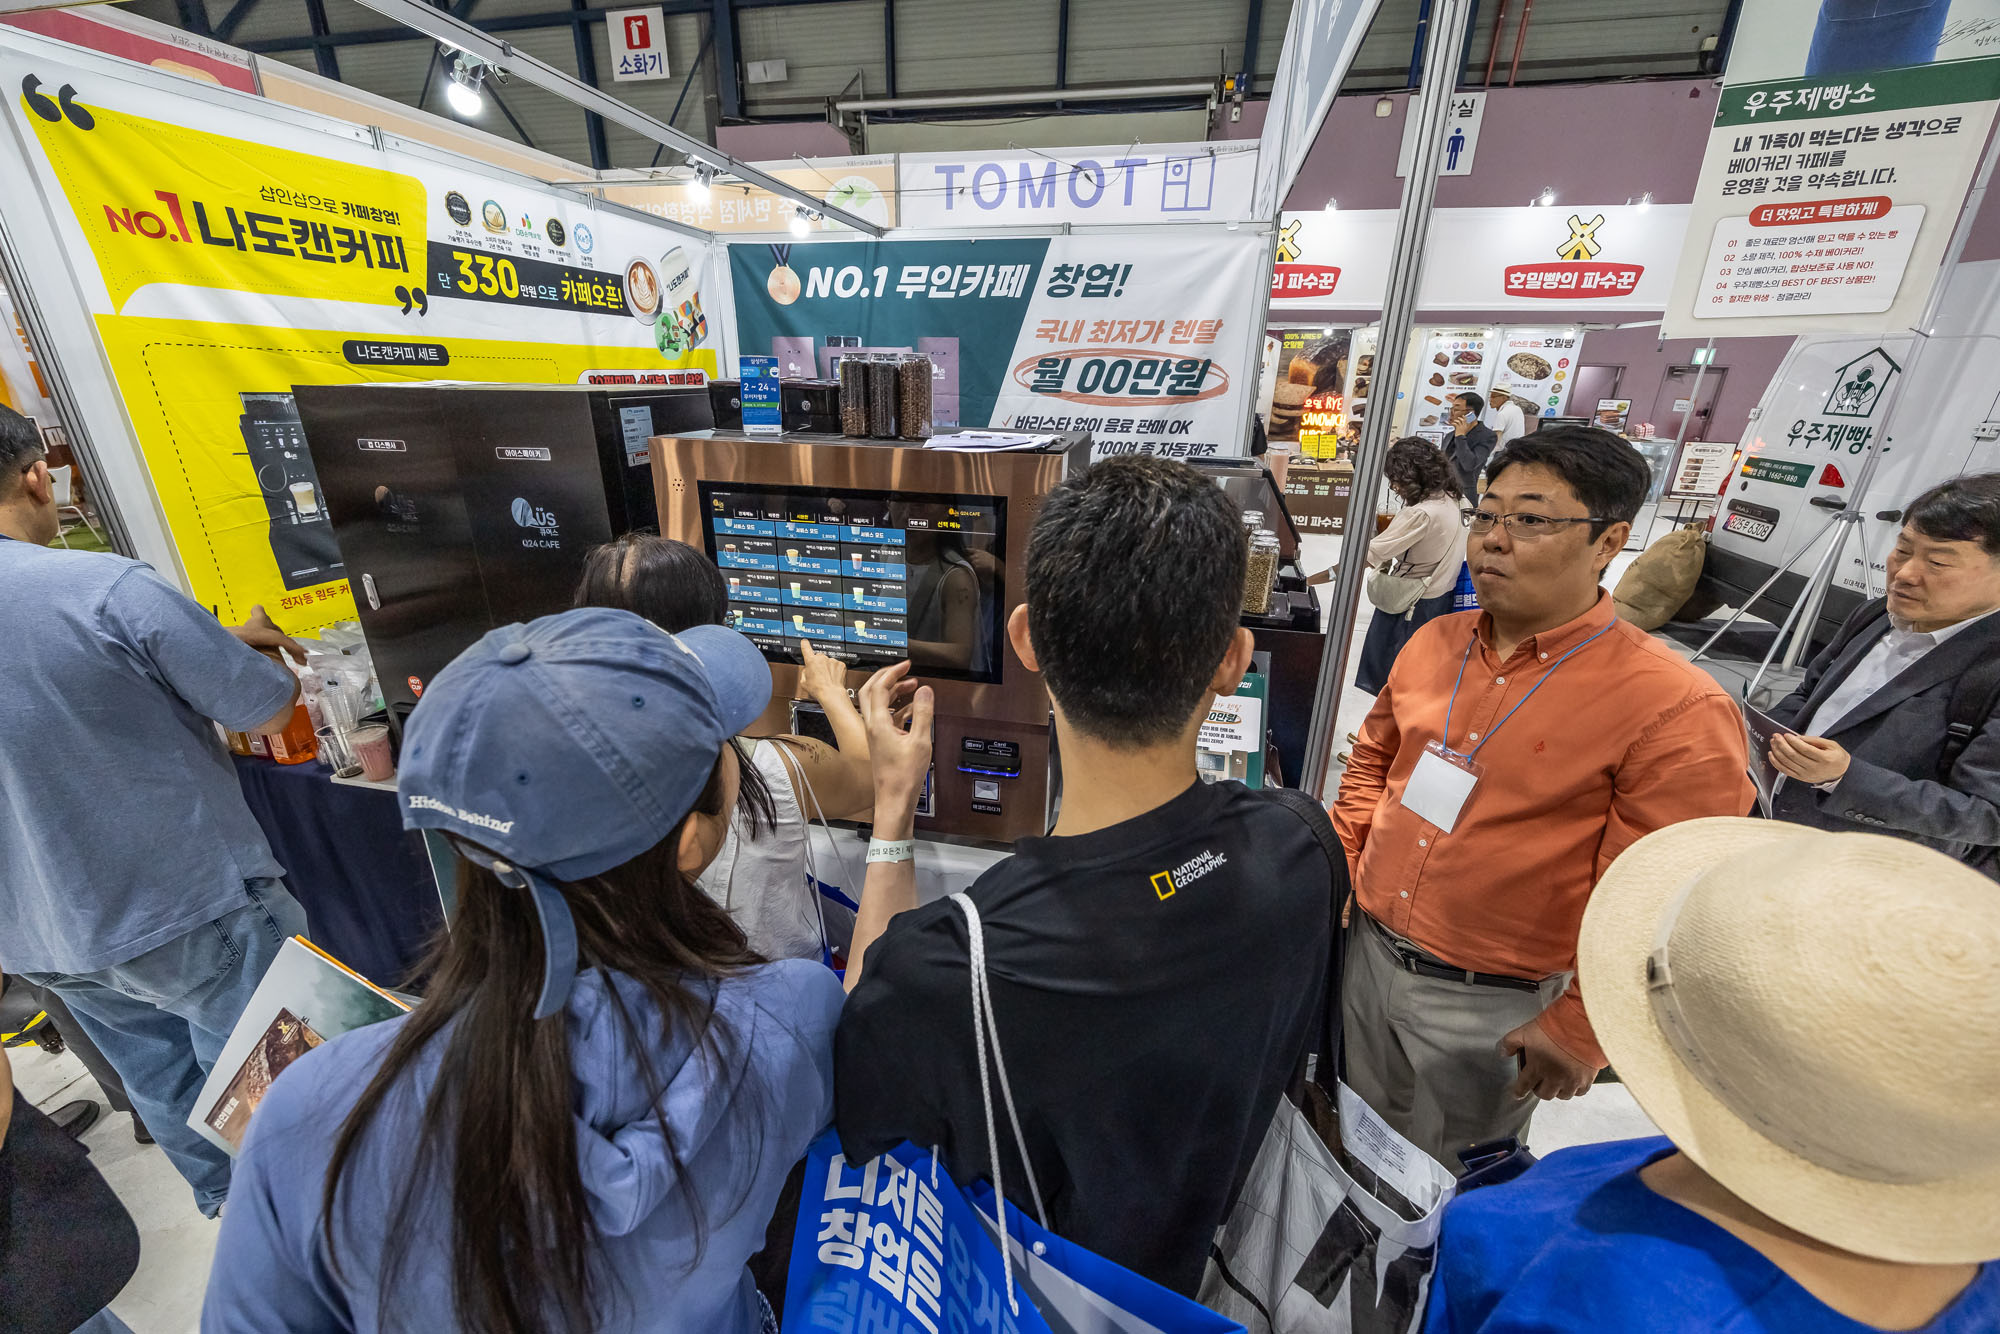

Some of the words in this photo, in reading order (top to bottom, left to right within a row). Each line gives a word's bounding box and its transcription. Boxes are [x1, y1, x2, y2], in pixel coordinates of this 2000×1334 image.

[619, 52, 663, 75] 소화기
[1744, 82, 1876, 118] 우주제빵소
[1733, 135, 1753, 153] 내
[1758, 131, 1804, 151] 가족이
[1809, 126, 1880, 148] 먹는다는
[1886, 116, 1962, 141] 생각으로
[1727, 154, 1790, 175] 베이커리
[1795, 149, 1847, 170] 카페를
[1722, 177, 1770, 197] 운영할
[1771, 175, 1803, 193] 것을
[1807, 167, 1898, 190] 약속합니다.
[259, 185, 339, 214] 샵인샵으로
[341, 201, 401, 227] 카페창업!
[1760, 206, 1773, 221] 더
[1776, 205, 1814, 221] 맛있고
[1817, 201, 1880, 218] 특별하게!
[102, 189, 193, 244] NO.1
[192, 200, 409, 274] 나도캔커피
[1727, 239, 1738, 248] 01
[1762, 237, 1788, 247] 재료만
[1817, 233, 1835, 243] 믿고
[1837, 232, 1856, 242] 먹을
[1857, 231, 1867, 241] 수
[1868, 231, 1887, 240] 있는
[1888, 229, 1899, 239] 빵
[1723, 254, 1736, 262] 02
[1741, 253, 1758, 262] 소량
[1778, 250, 1803, 260] 100%
[1805, 248, 1824, 258] 수제
[1825, 247, 1865, 257] 베이커리!
[1719, 268, 1732, 276] 03
[1736, 267, 1753, 276] 안심
[1790, 262, 1835, 273] 합성보존료
[1836, 261, 1855, 271] 사용
[1855, 261, 1874, 270] NO!
[806, 265, 888, 300] NO.1
[896, 263, 1026, 300] 무인카페
[1047, 262, 1133, 299] 창업!
[1287, 272, 1335, 290] 파수꾼
[1507, 269, 1578, 290] 호밀빵의
[1581, 269, 1636, 290] 파수꾼
[1715, 282, 1728, 290] 04
[1733, 279, 1780, 289] 우주제빵소의
[1781, 278, 1805, 287] BEST
[1806, 277, 1819, 286] OF
[1820, 276, 1845, 285] BEST
[438, 272, 451, 289] 단
[560, 276, 624, 309] 카페오픈!
[1712, 295, 1724, 303] 05
[1753, 293, 1770, 303] 위생
[1035, 319, 1083, 344] 국내
[1090, 318, 1165, 344] 최저가
[1171, 318, 1225, 345] 렌탈
[356, 343, 416, 362] 나도캔커피
[417, 345, 440, 363] 세트
[1544, 338, 1575, 349] 호밀빵
[743, 382, 750, 391] 2
[758, 382, 769, 392] 24
[1032, 357, 1067, 395] 월
[1077, 358, 1210, 396] 00만원
[1325, 396, 1344, 411] RYE
[1014, 415, 1071, 432] 바리스타
[1072, 416, 1103, 432] 없이
[1104, 416, 1135, 434] 음료
[1135, 417, 1166, 434] 판매
[1168, 419, 1193, 435] OK
[1300, 412, 1348, 428] SANDWICH
[1787, 419, 1893, 455] 우주제빵
[505, 448, 542, 459] 아이스메이커
[1159, 442, 1218, 458] 자동제조
[1310, 516, 1343, 529] 파수꾼
[522, 539, 538, 548] Q24
[539, 540, 561, 549] CAFE
[280, 592, 314, 610] 전자동
[315, 587, 337, 601] 원두
[456, 808, 515, 834] Behind
[1172, 849, 1214, 879] NATIONAL
[1175, 852, 1227, 889] GEOGRAPHIC
[823, 1152, 944, 1267] 디저트
